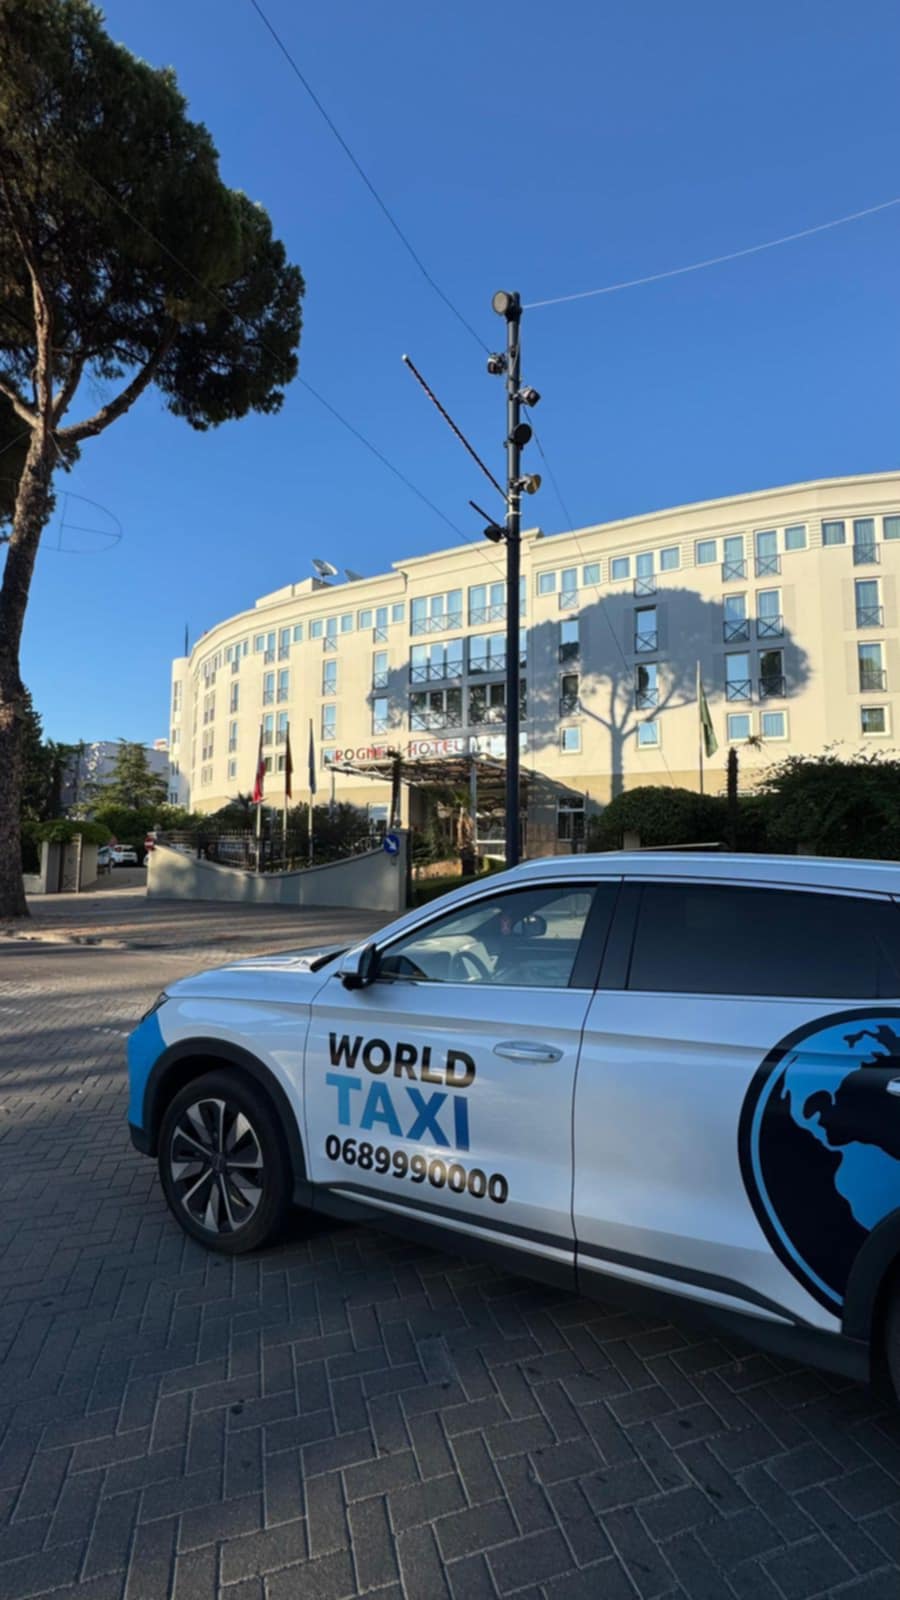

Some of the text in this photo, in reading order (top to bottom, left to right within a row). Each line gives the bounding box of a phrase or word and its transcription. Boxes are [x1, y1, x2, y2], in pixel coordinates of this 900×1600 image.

[408, 739, 462, 756] HOTEL
[329, 1032, 476, 1088] WORLD
[326, 1073, 470, 1152] TAXI
[325, 1134, 508, 1204] 0689990000
